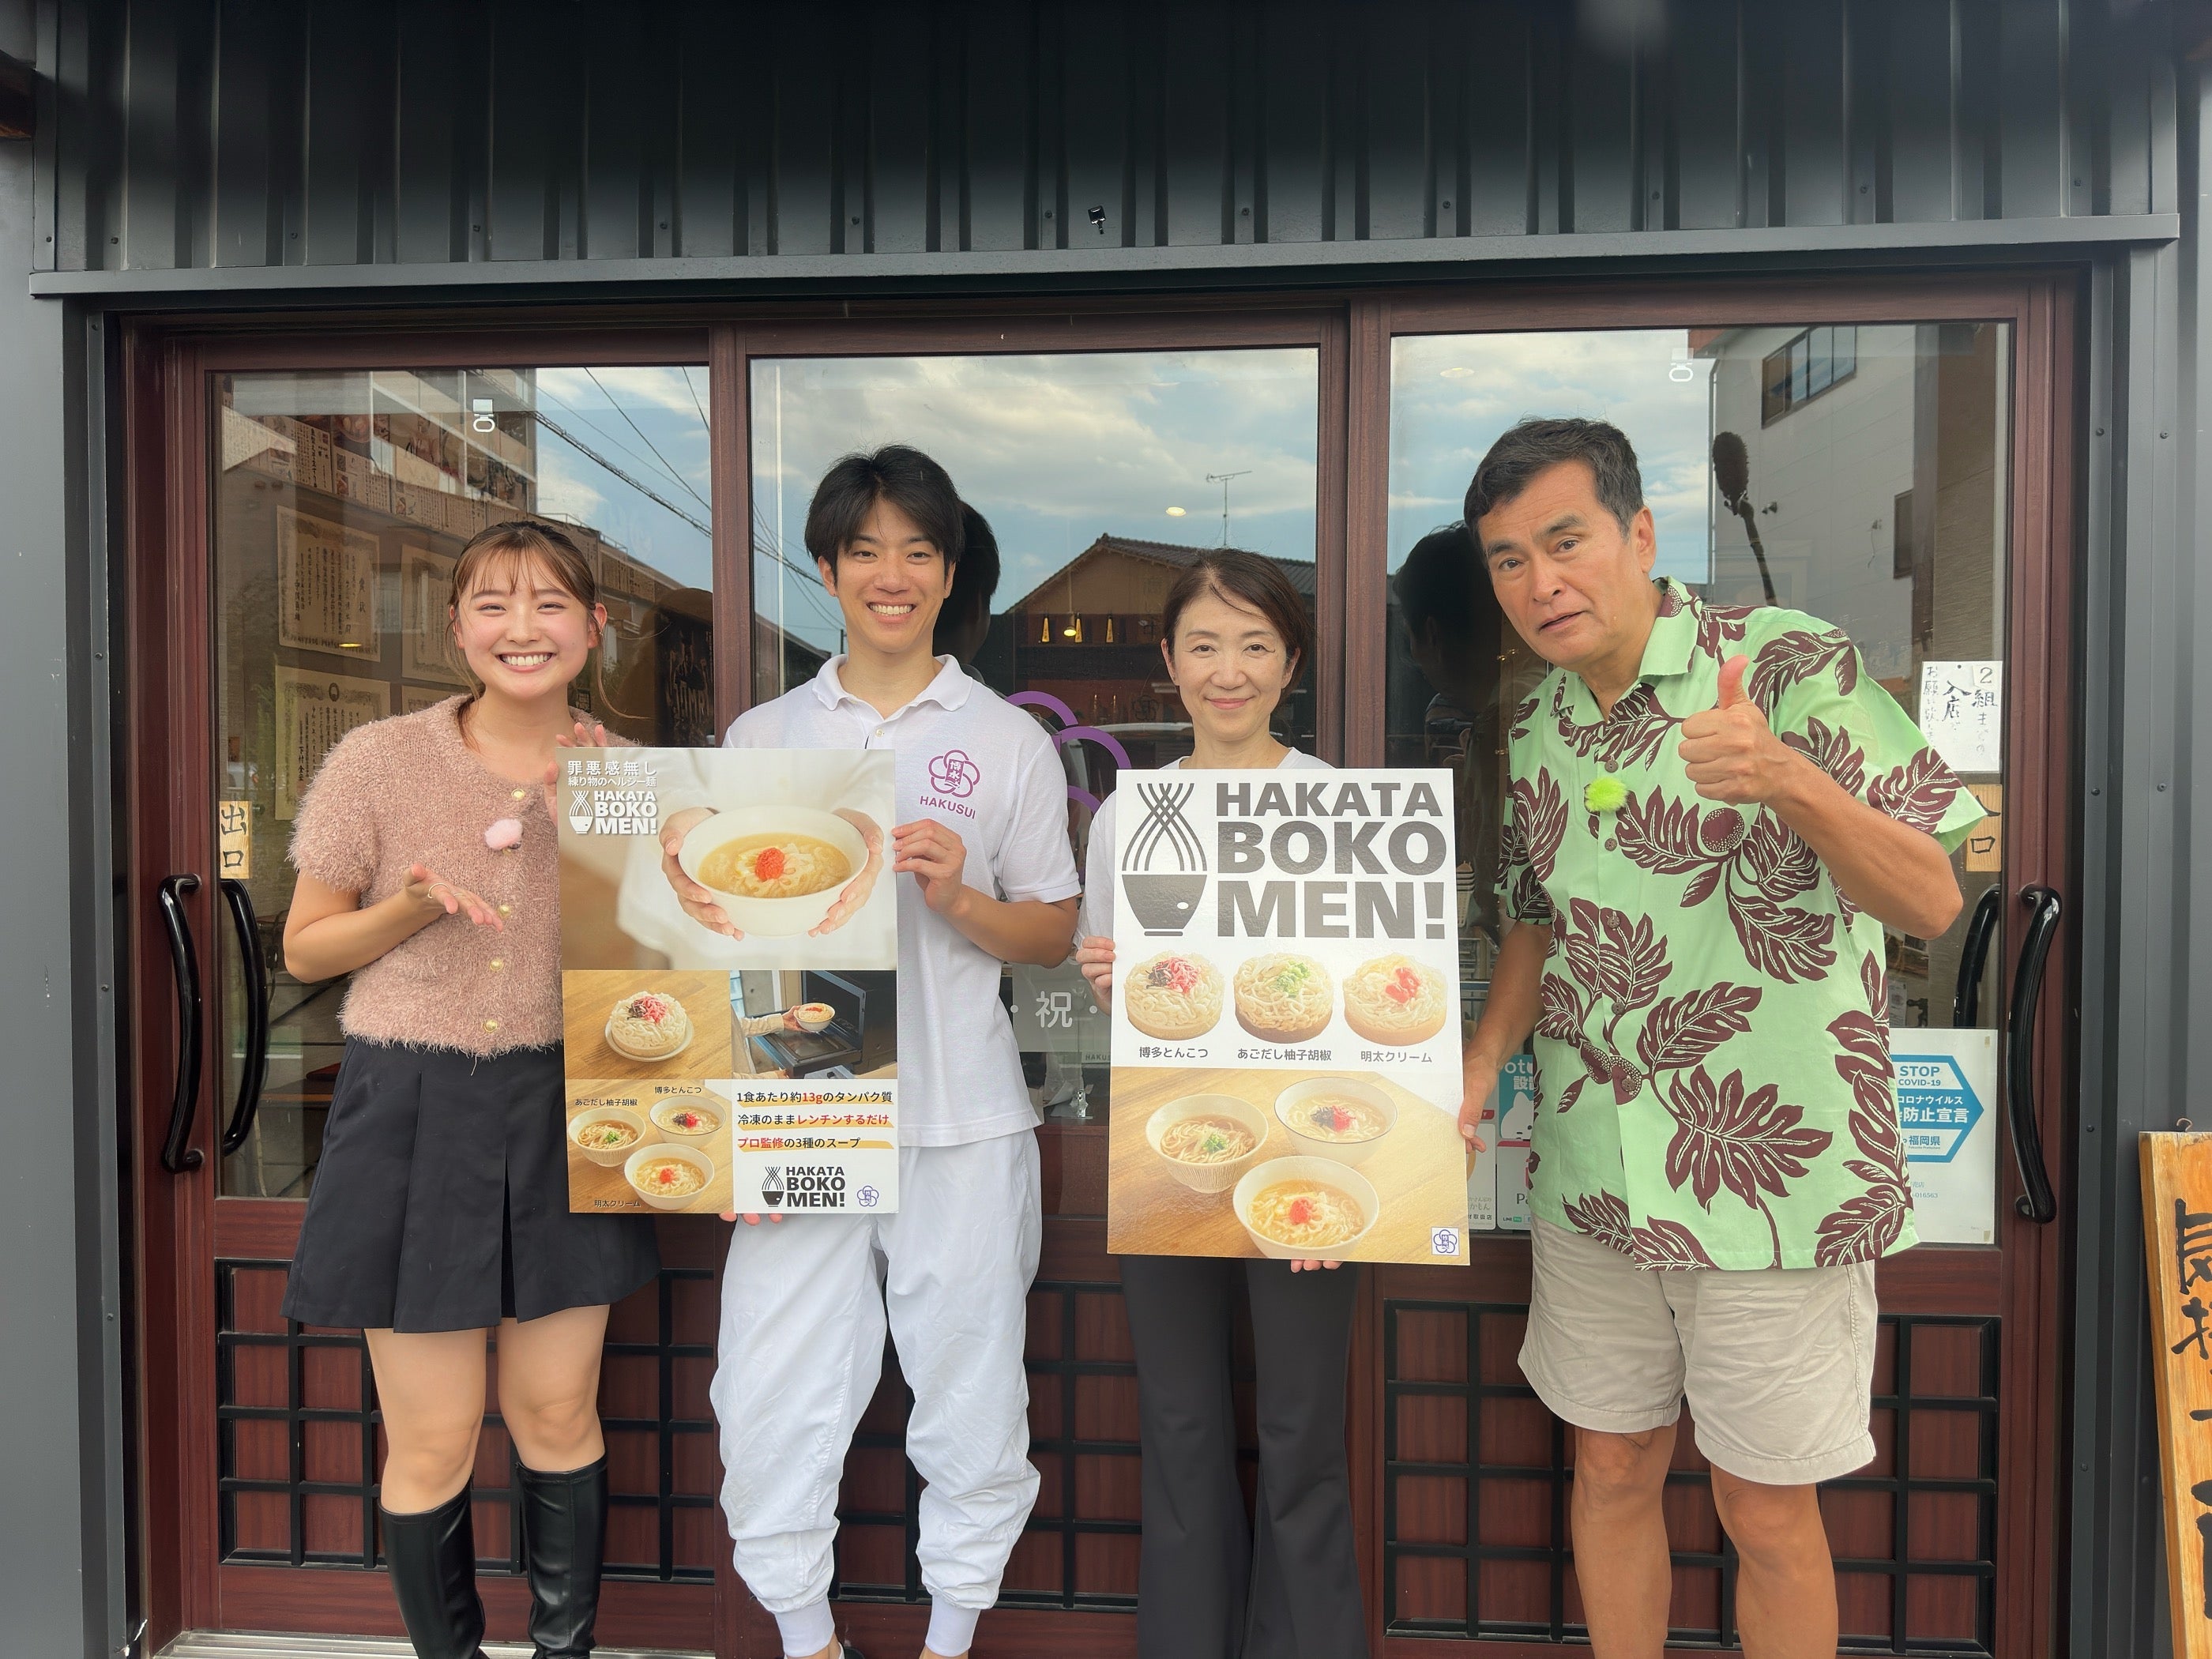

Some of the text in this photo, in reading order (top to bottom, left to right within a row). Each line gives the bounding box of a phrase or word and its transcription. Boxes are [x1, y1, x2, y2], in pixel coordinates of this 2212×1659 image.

[567, 761, 657, 776] 罪悪感無し
[568, 777, 657, 788] 練り物のヘルシー麺
[594, 790, 656, 801] HAKATA
[1216, 782, 1443, 817] HAKATA
[595, 801, 657, 818] BOKO
[920, 796, 976, 819] HAKUSUI
[596, 818, 657, 835] MEN!
[221, 803, 247, 867] 出口
[1217, 820, 1446, 876] BOKO
[1217, 880, 1446, 939] MEN!
[1138, 1045, 1209, 1059] 博多とんこつ
[1237, 1048, 1332, 1063] あごだし柚子胡椒
[1360, 1051, 1433, 1063] 明太クリーム
[1900, 1066, 1940, 1077] STOP
[654, 1085, 702, 1095] 博多とんこつ
[574, 1097, 638, 1107] あごだし柚子胡椒
[736, 1091, 893, 1104] 1食あたり約13gのタンパク質
[737, 1113, 890, 1127] 冷凍のままレンチンするだけ
[738, 1136, 861, 1149] プロ監修の3種のスープ
[786, 1166, 845, 1176] HAKATA
[786, 1176, 845, 1191] BOKO
[594, 1198, 641, 1209] 明太クリーム
[787, 1191, 845, 1207] MEN!
